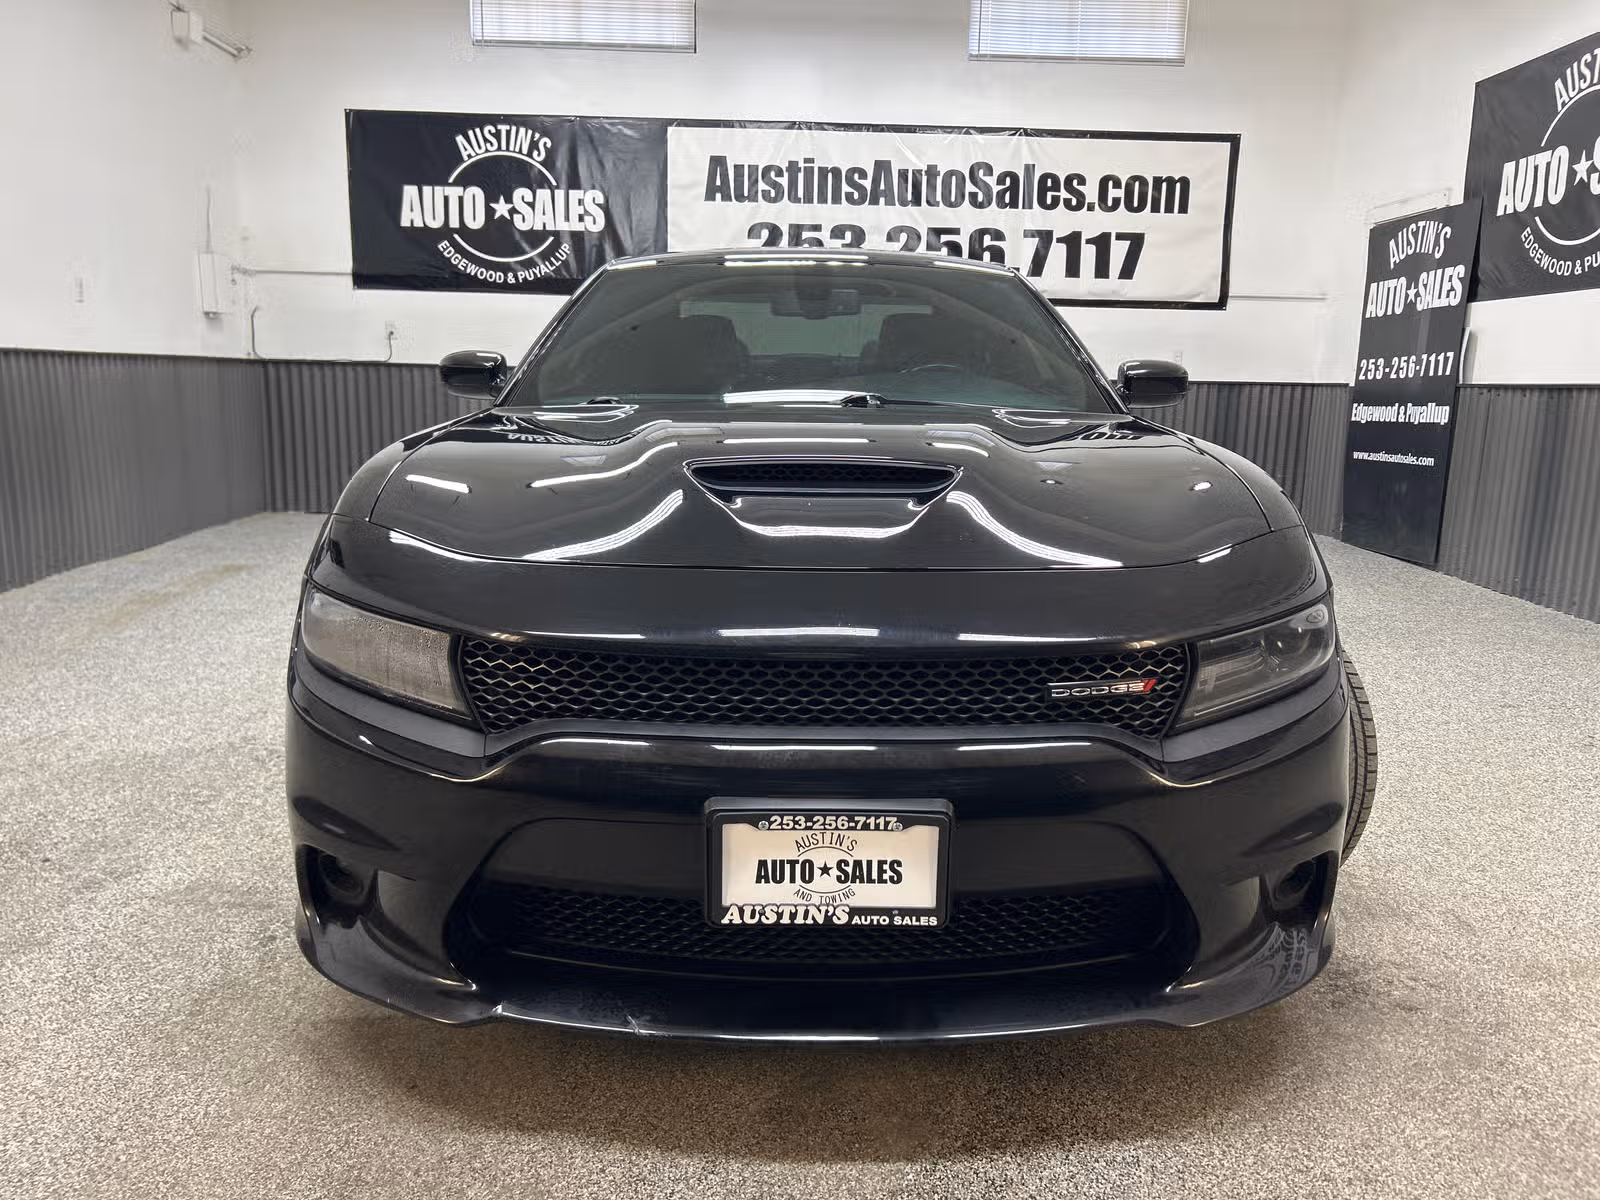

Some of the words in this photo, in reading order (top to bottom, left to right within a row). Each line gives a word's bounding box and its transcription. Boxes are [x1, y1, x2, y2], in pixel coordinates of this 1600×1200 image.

[455, 124, 552, 162] AUSTIN'S
[704, 155, 1191, 214] AustinsAutoSales.com
[1497, 145, 1569, 216] AUTO
[400, 184, 485, 230] AUTO
[512, 187, 606, 232] SALES
[1389, 220, 1451, 270] AUSTIN'S
[1520, 226, 1572, 276] EDGEWOOD
[1573, 259, 1582, 275] &
[437, 240, 504, 283] EDGEWOOD
[507, 273, 516, 284] &
[517, 243, 571, 283] PUYALLUP
[1365, 276, 1407, 318] AUTO
[1416, 264, 1466, 312] SALES
[1358, 351, 1455, 380] 253-256-7117
[1351, 402, 1399, 424] Edgewood
[1398, 405, 1405, 423] &
[1405, 402, 1450, 426] Puyallup
[1353, 450, 1434, 467] www.austinsautosales.com
[1051, 682, 1145, 697] DODGE
[769, 815, 896, 831] 253-256-7117
[794, 831, 858, 853] AUSTIN'S
[755, 858, 815, 885] AUTO
[836, 858, 903, 885] SALES
[793, 888, 813, 903] AND
[819, 887, 856, 905] TOWING
[720, 904, 850, 925] AUSTIN'S
[851, 915, 889, 926] AUTO
[893, 915, 938, 927] SALES
